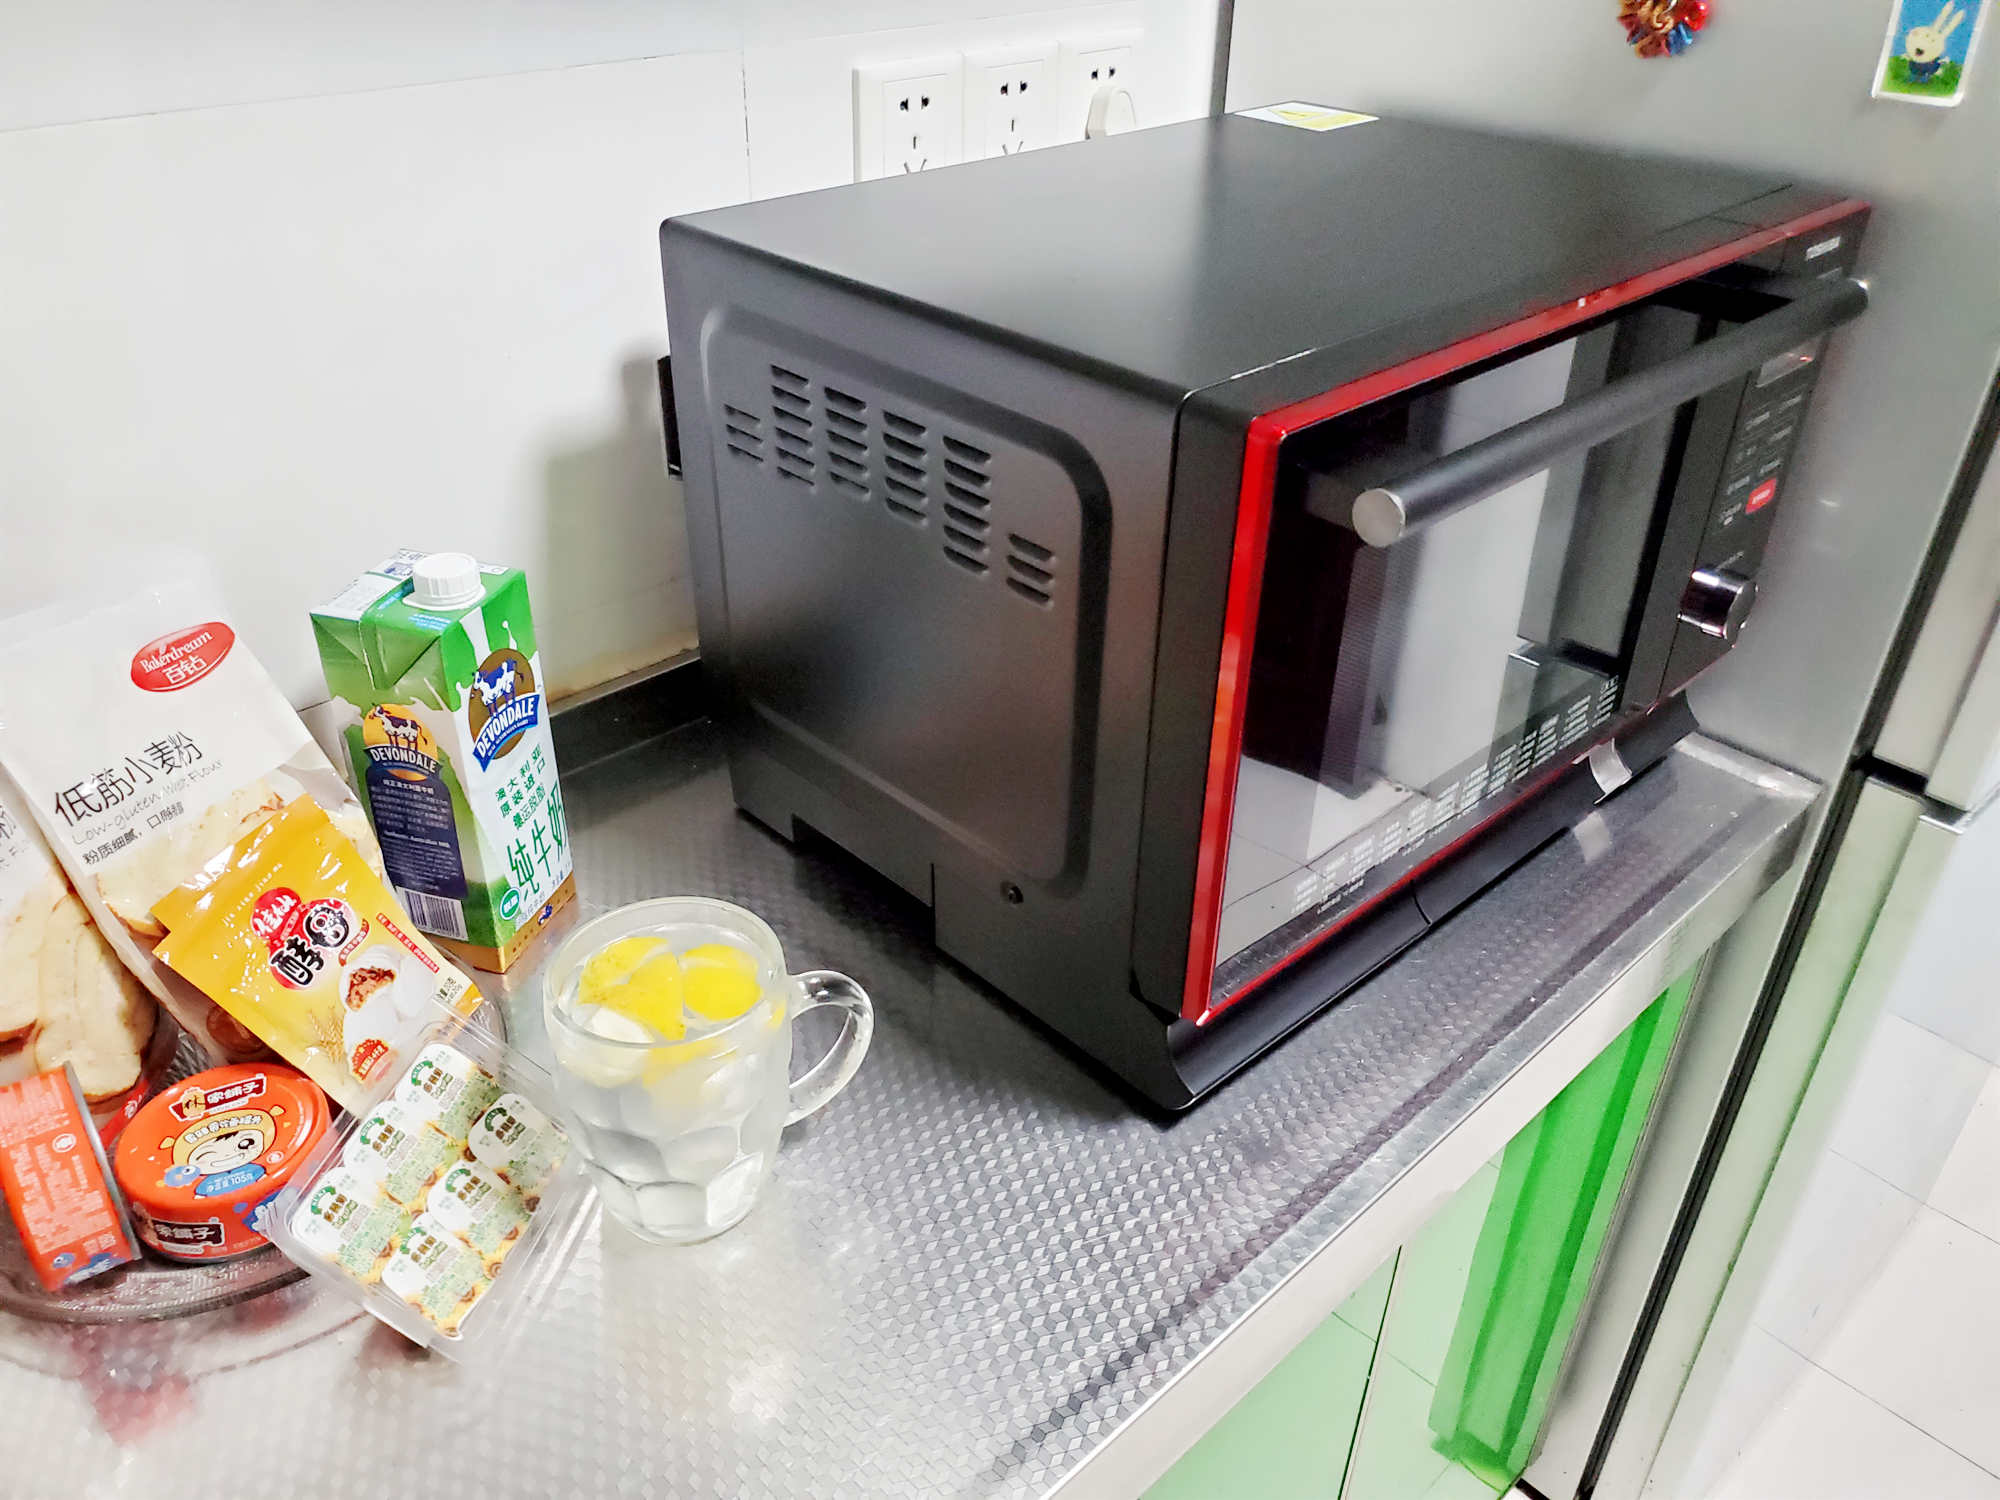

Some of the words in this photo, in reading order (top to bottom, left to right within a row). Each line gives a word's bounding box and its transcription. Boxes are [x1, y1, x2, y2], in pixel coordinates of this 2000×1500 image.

[140, 631, 214, 673] Bakerdream
[162, 656, 207, 684] 百钻
[477, 697, 535, 758] DEVONDALE
[55, 731, 203, 827] 低筋小麦粉
[369, 747, 437, 774] DEVONDALE
[72, 793, 161, 845] Low-gluten
[188, 759, 223, 783] Flour
[507, 779, 567, 902] 纯牛奶
